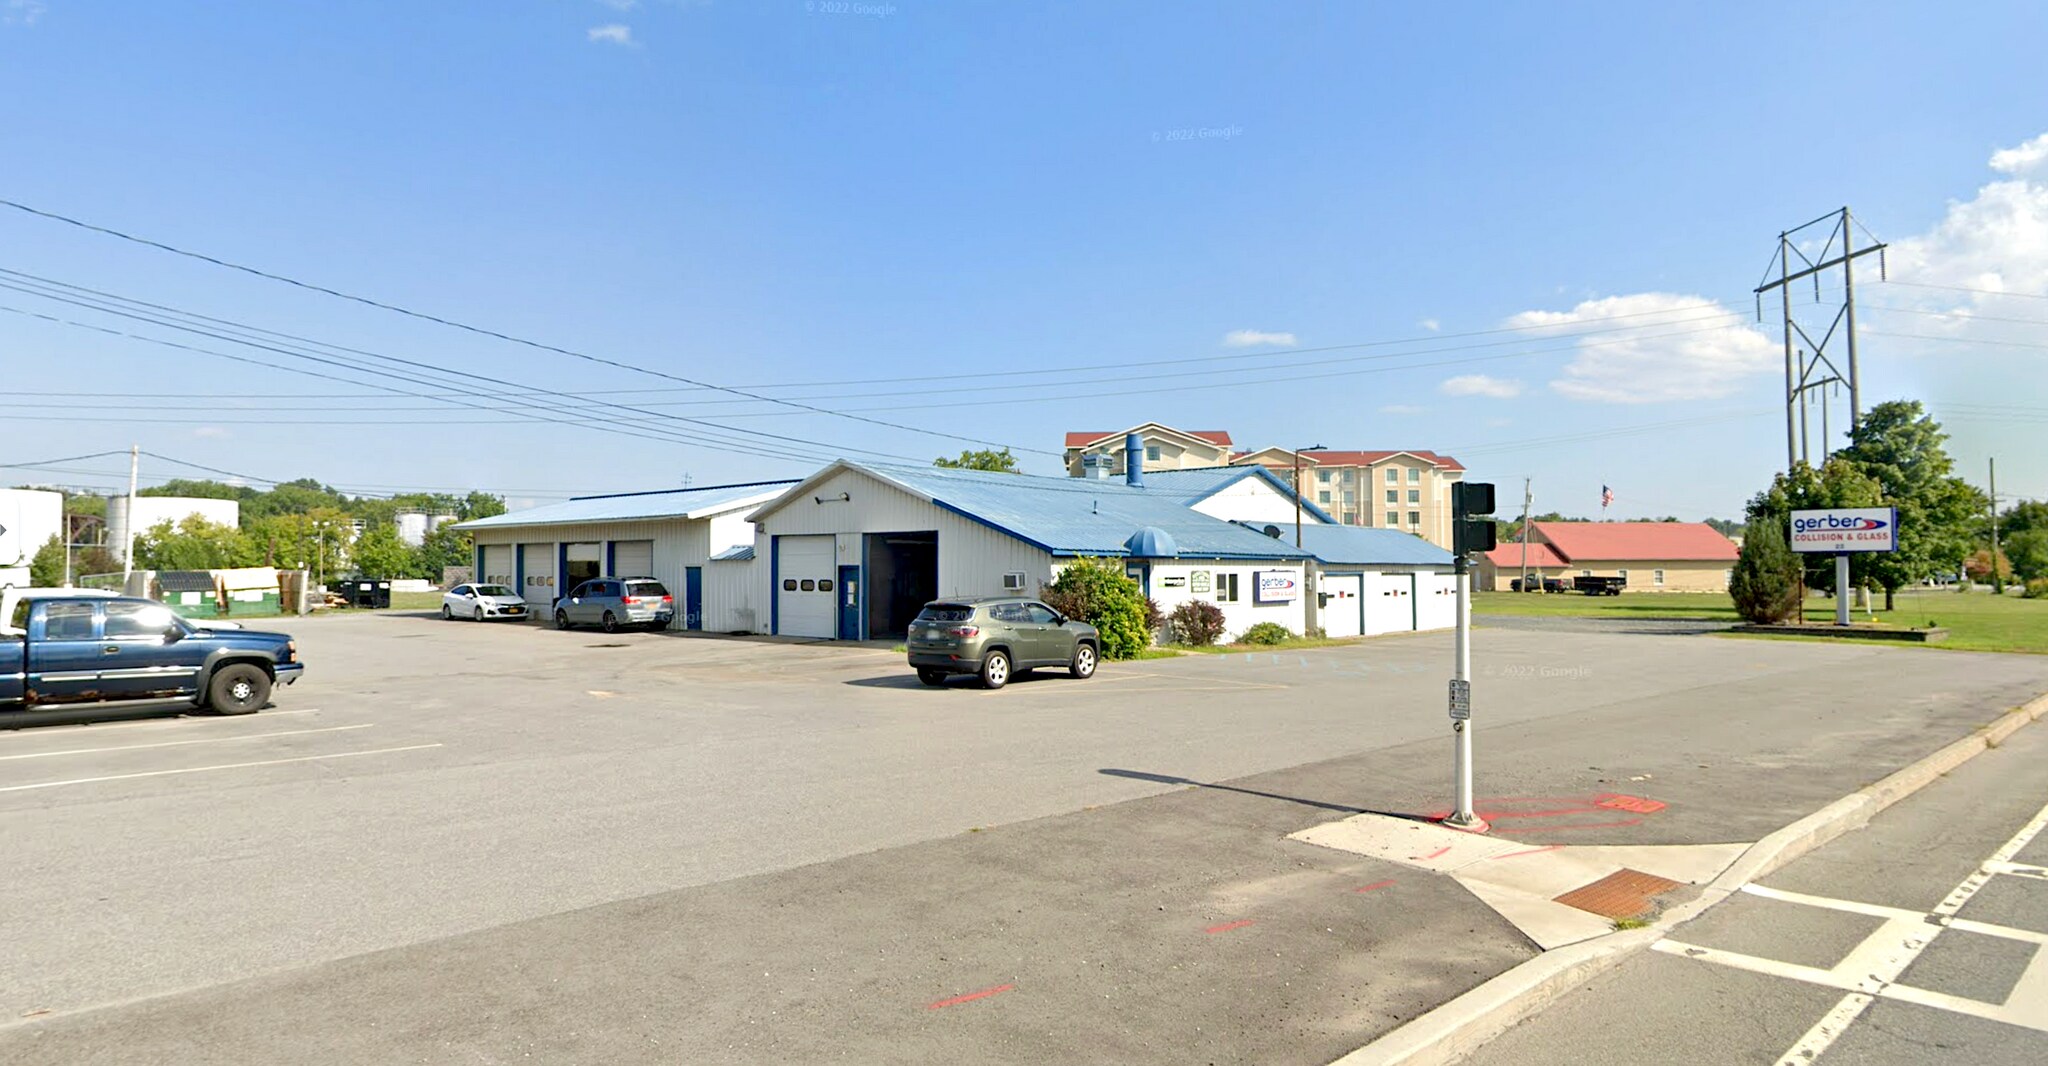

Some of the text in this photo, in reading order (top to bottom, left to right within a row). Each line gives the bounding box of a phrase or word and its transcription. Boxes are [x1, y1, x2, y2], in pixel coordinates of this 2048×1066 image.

[1794, 514, 1863, 532] gerber
[1794, 533, 1843, 541] COLLISION
[1857, 532, 1888, 540] GLASS
[1261, 577, 1287, 590] gerber
